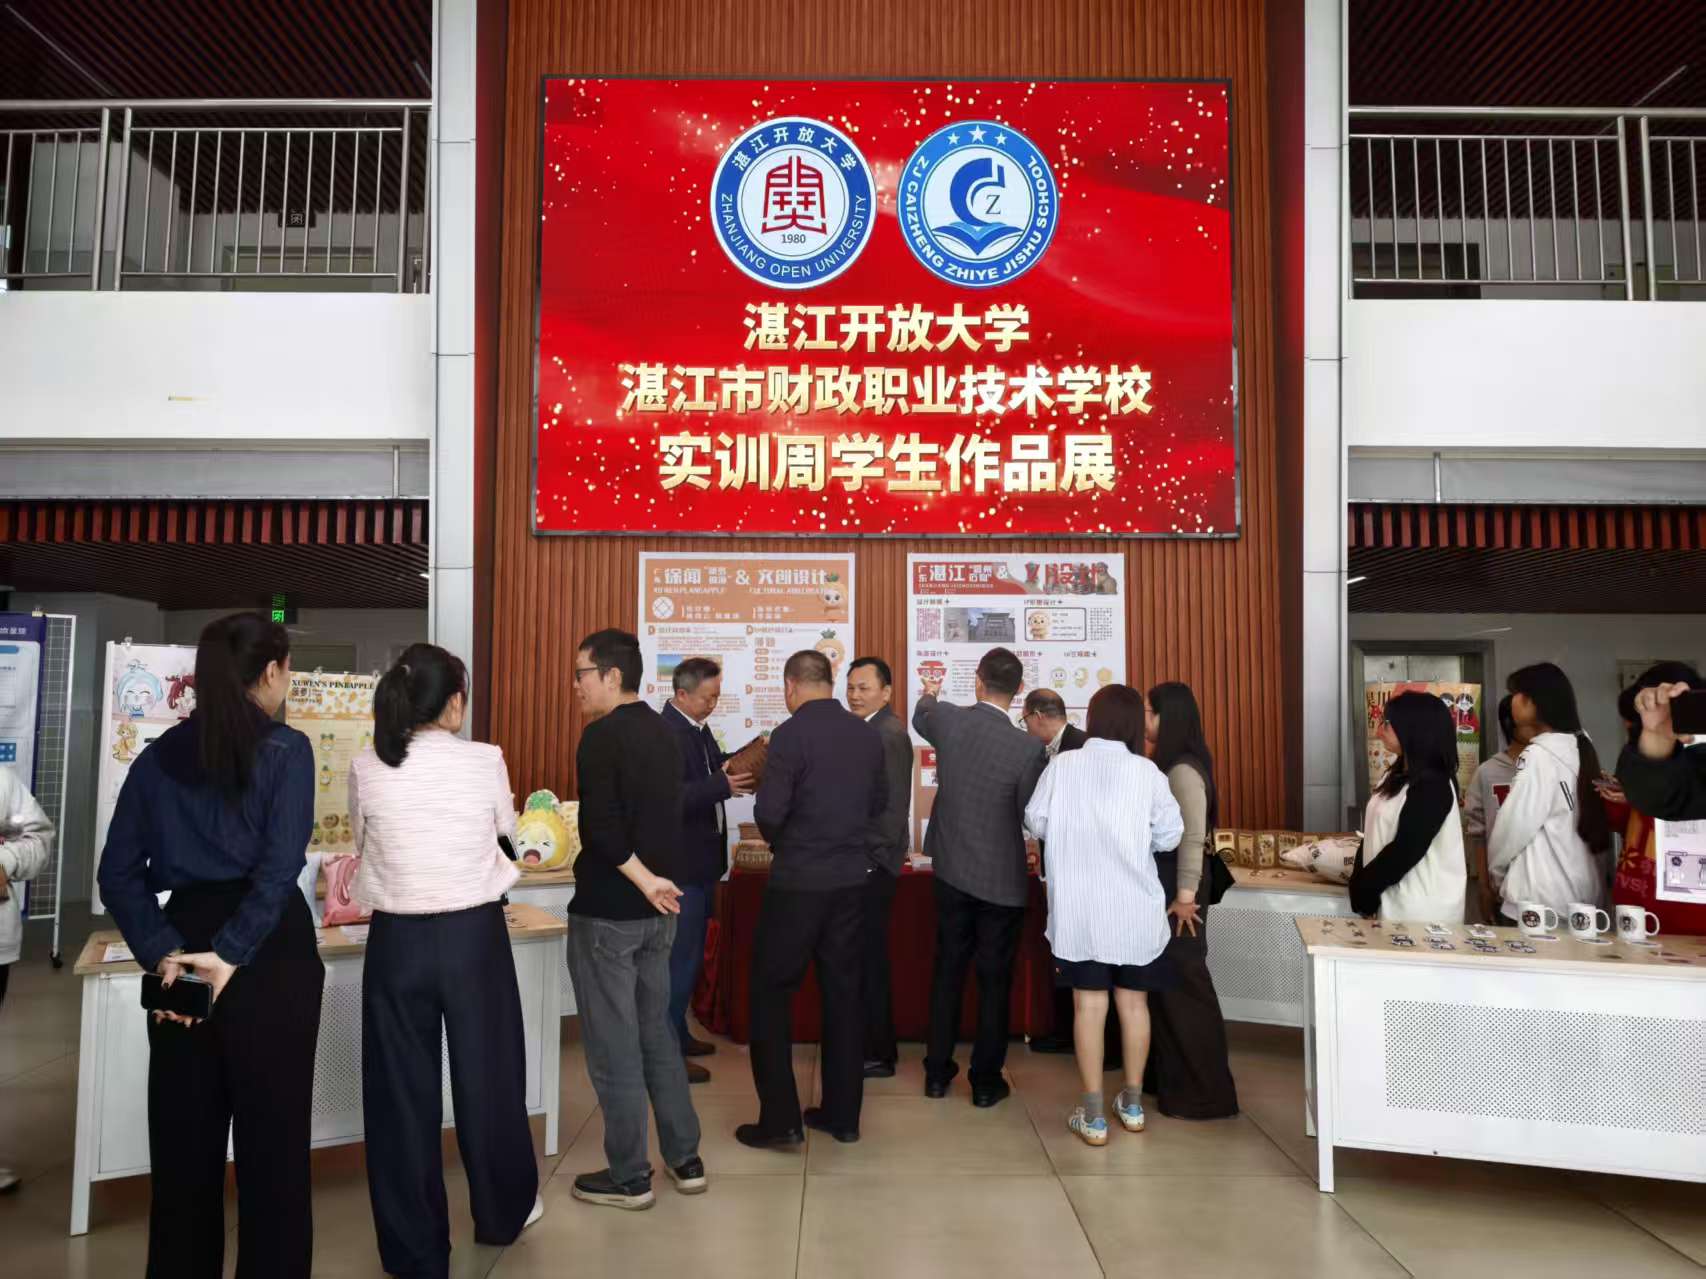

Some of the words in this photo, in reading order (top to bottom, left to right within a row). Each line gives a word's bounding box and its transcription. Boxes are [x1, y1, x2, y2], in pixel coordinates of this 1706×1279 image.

[732, 127, 857, 171] 湛江开放大学
[913, 156, 929, 178] ZJ
[1027, 155, 1050, 229] SCHOOL
[721, 193, 766, 269] ZHANJIANG
[770, 263, 811, 278] OPEN
[815, 195, 866, 273] UNIVERSITY
[782, 234, 806, 244] 1980
[906, 181, 945, 268] CAIZHENG
[944, 263, 999, 280] ZHIYE
[1004, 231, 1042, 275] JISHU
[743, 303, 1030, 352] 湛江开放大学
[620, 363, 1153, 415] 湛江市财政职业技术学校
[659, 432, 1117, 492] 实训周学生作品展
[758, 568, 827, 585] 文创设计
[329, 681, 374, 690] PINEAPPLE
